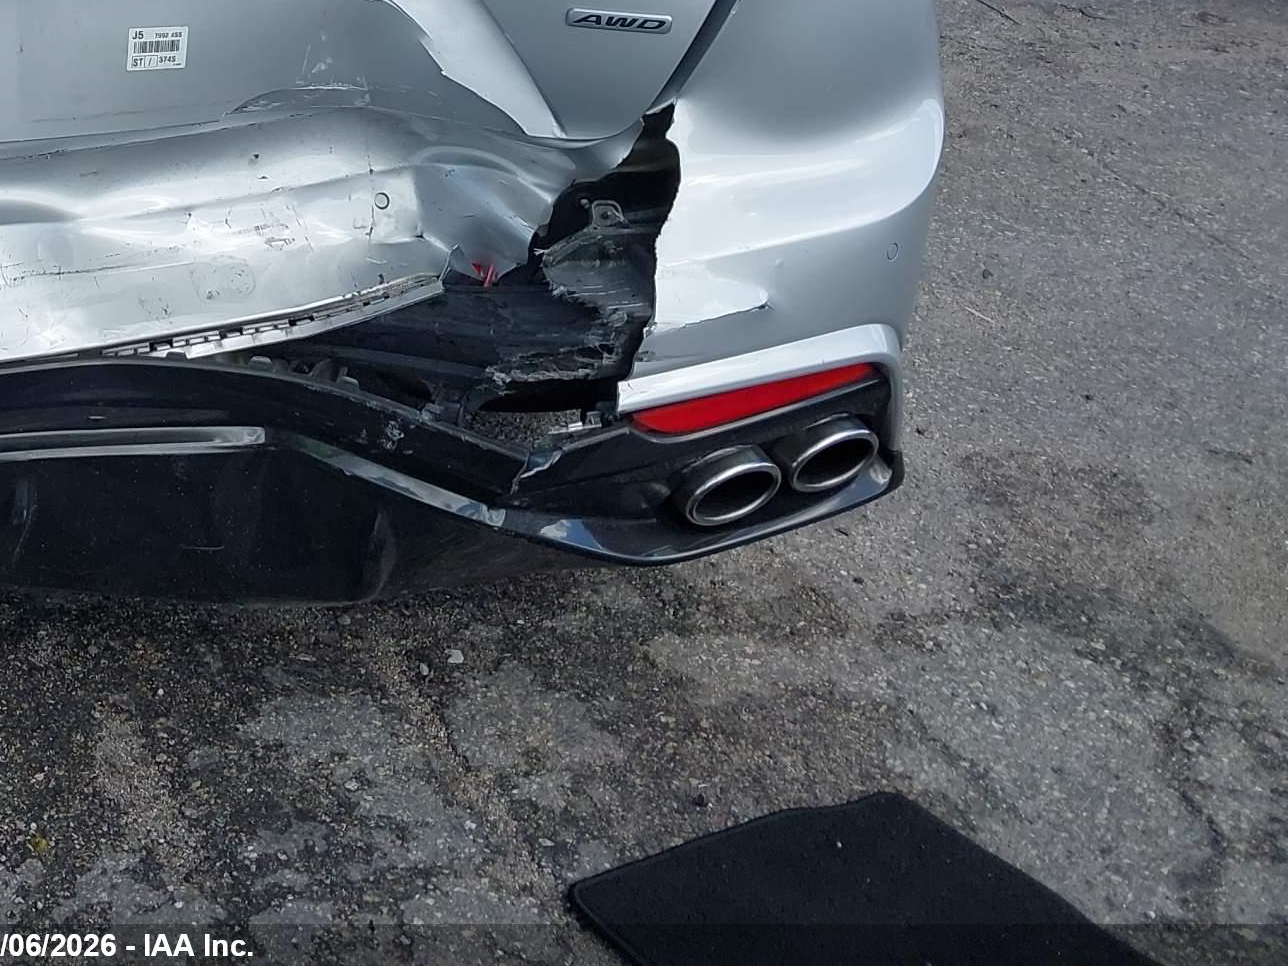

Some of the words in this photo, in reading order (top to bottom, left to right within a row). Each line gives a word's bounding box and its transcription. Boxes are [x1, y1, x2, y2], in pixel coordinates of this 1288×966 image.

[573, 14, 667, 30] AWD
[132, 30, 144, 40] J5
[132, 57, 143, 67] ST
